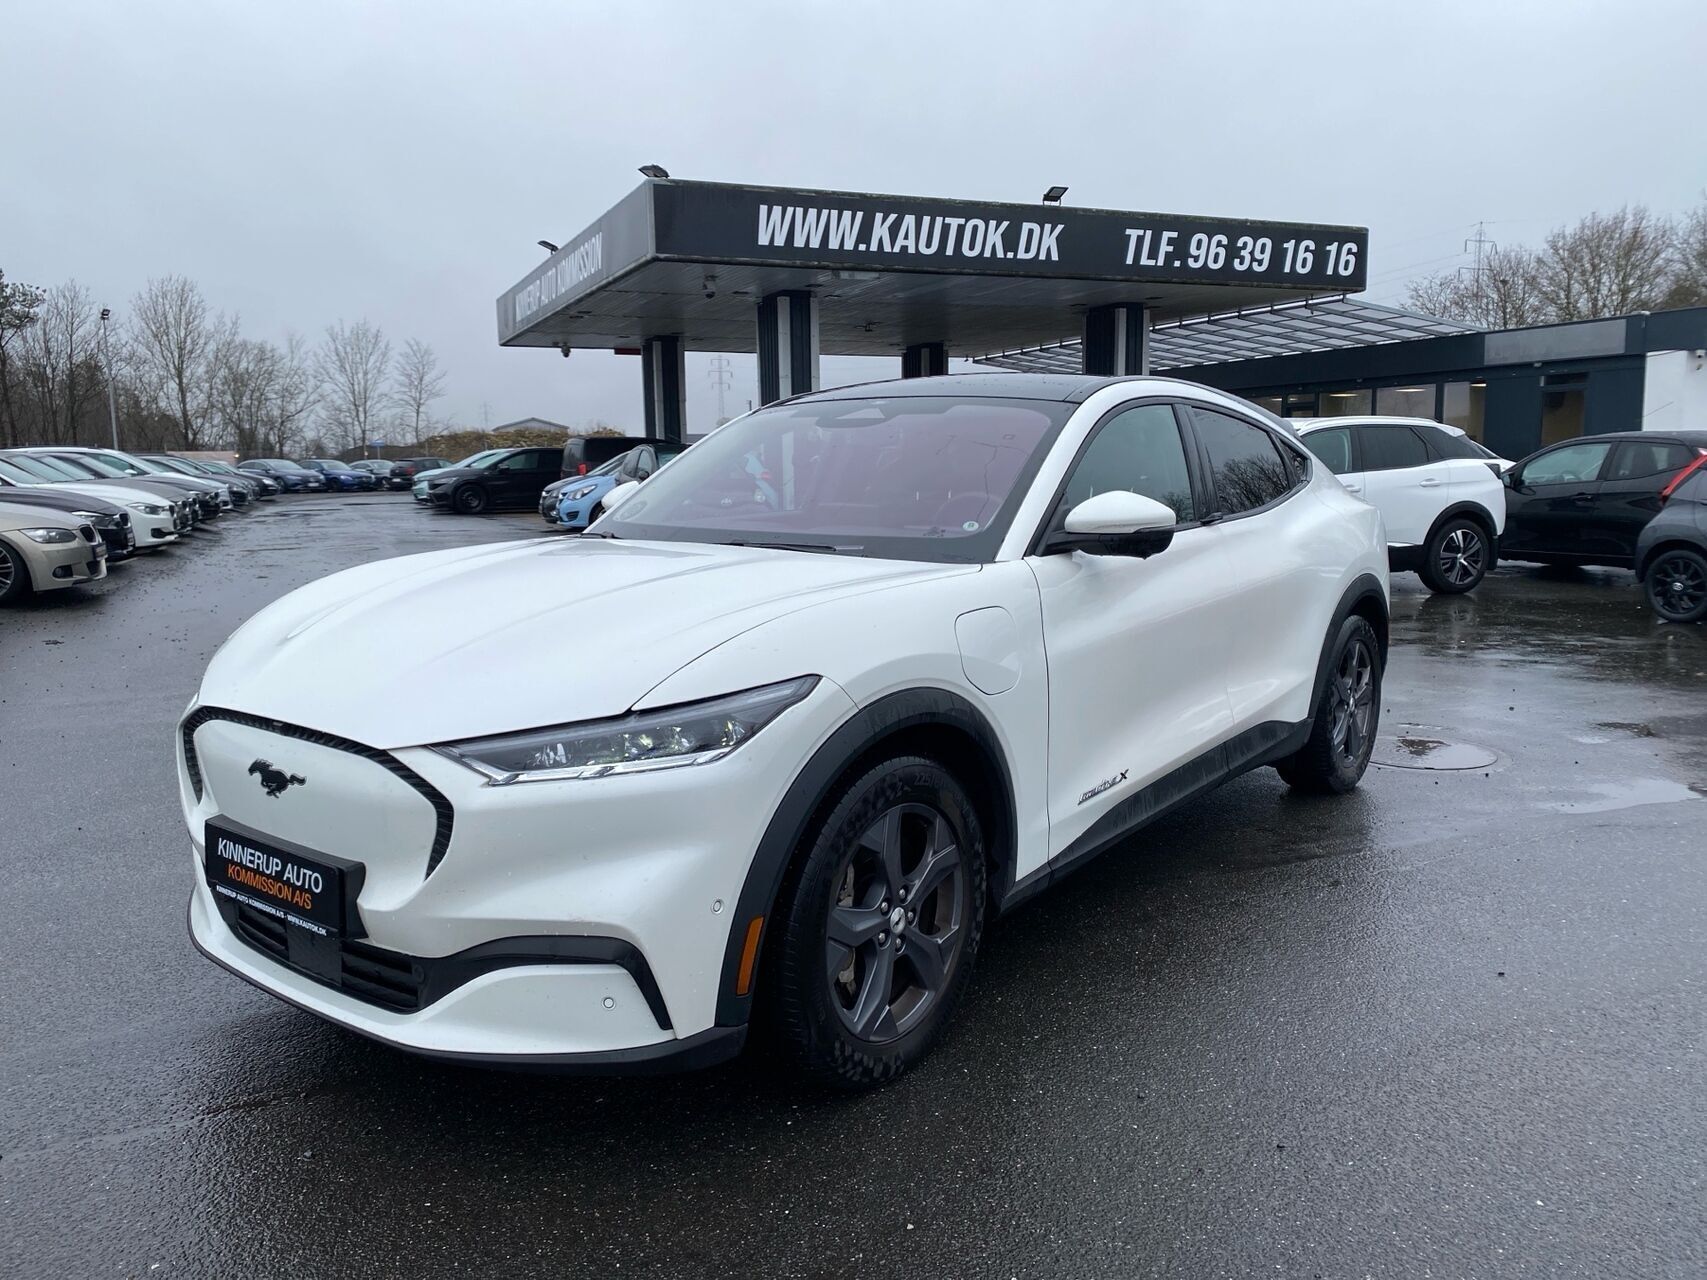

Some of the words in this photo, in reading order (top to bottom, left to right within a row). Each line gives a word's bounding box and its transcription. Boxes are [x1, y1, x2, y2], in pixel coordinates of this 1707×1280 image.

[757, 204, 1065, 262] WWW.KAUTOK.DK
[1124, 228, 1181, 268] TLF.
[1188, 233, 1226, 270] 96
[1233, 236, 1272, 273] 39
[1283, 239, 1313, 275] 16
[1325, 241, 1358, 277] 16
[217, 837, 282, 877] KINNERUP
[283, 863, 323, 894] AUTO
[228, 864, 293, 901] KOMMISSION
[293, 891, 312, 910] A/S
